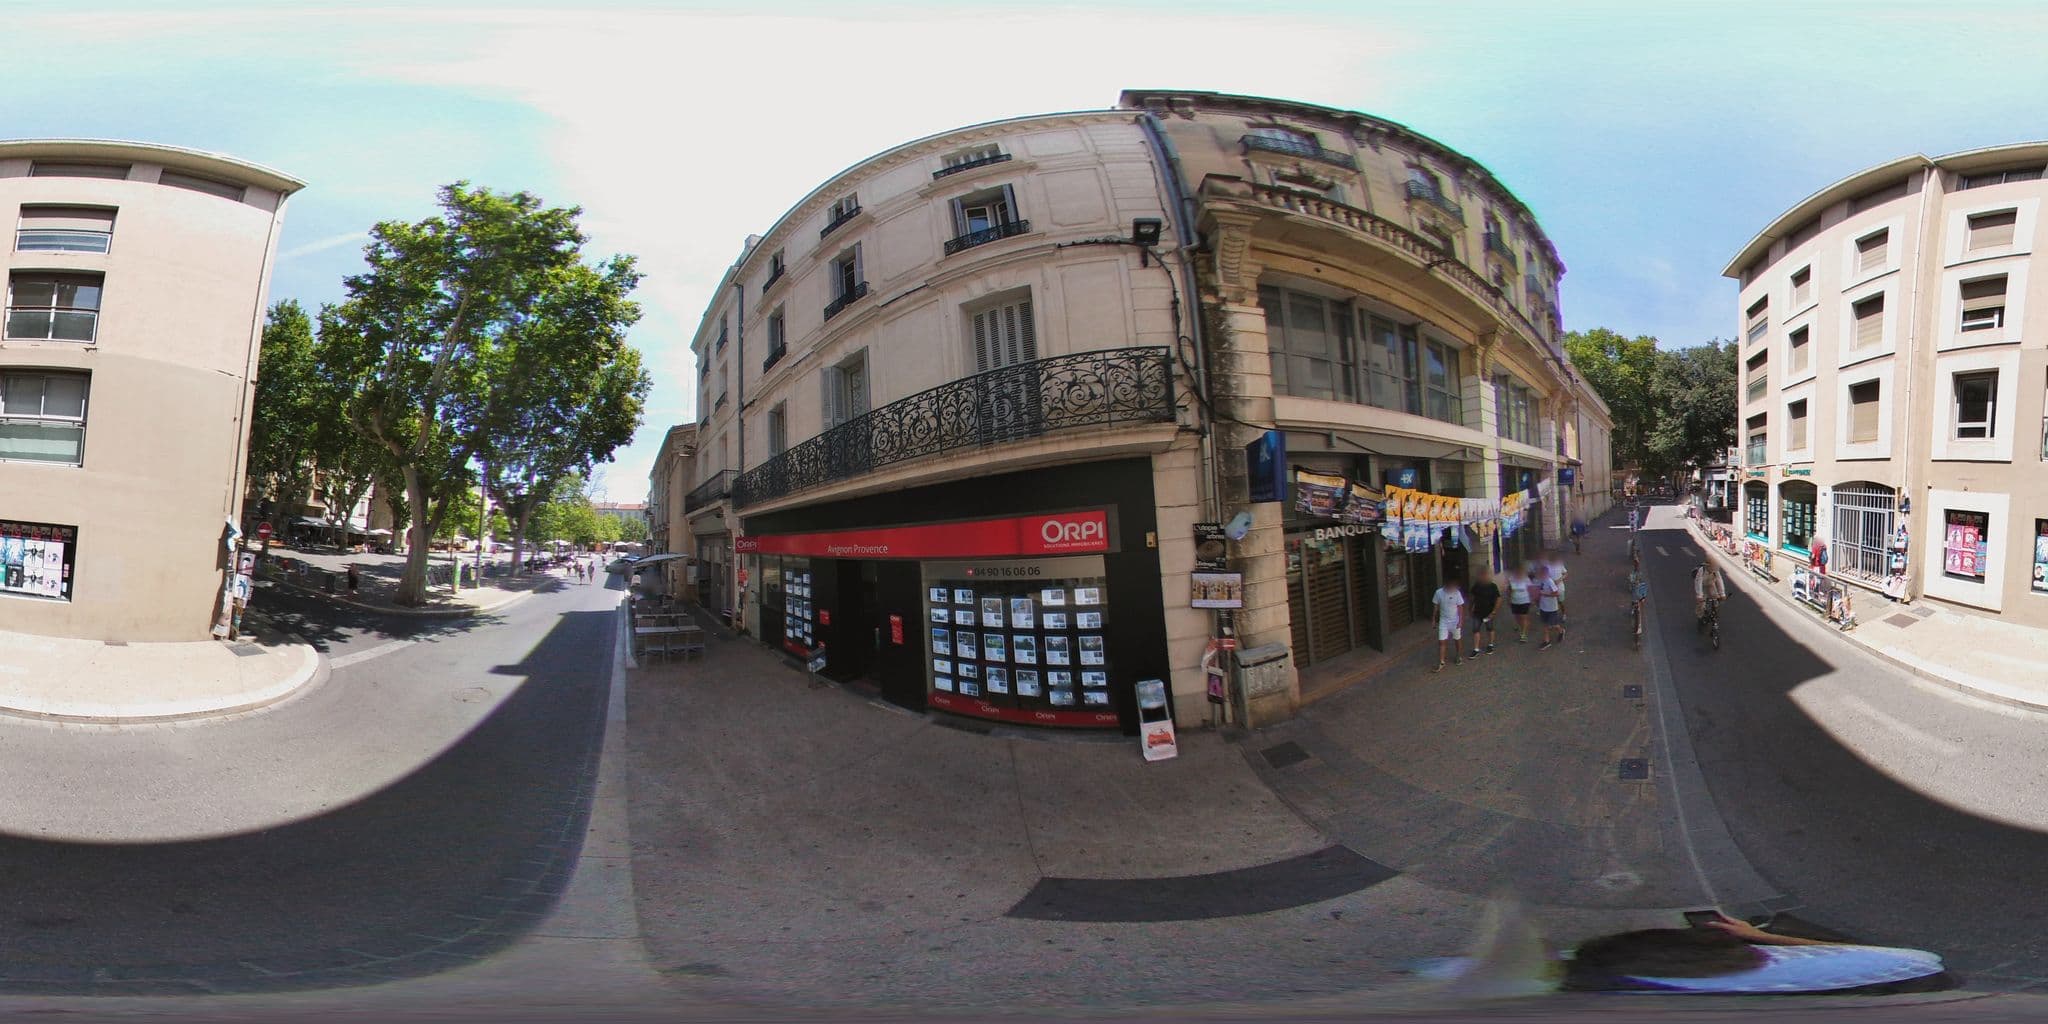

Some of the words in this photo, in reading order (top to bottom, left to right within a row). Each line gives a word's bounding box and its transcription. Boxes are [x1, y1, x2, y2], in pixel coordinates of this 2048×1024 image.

[1041, 520, 1104, 543] ORPI
[1315, 524, 1372, 541] BANQUE
[736, 540, 758, 549] ORPI
[828, 545, 852, 556] Avignon
[853, 544, 888, 555] Provence
[987, 567, 999, 577] 90
[1001, 567, 1012, 577] 16
[1013, 567, 1026, 576] 06
[1028, 566, 1041, 576] 06
